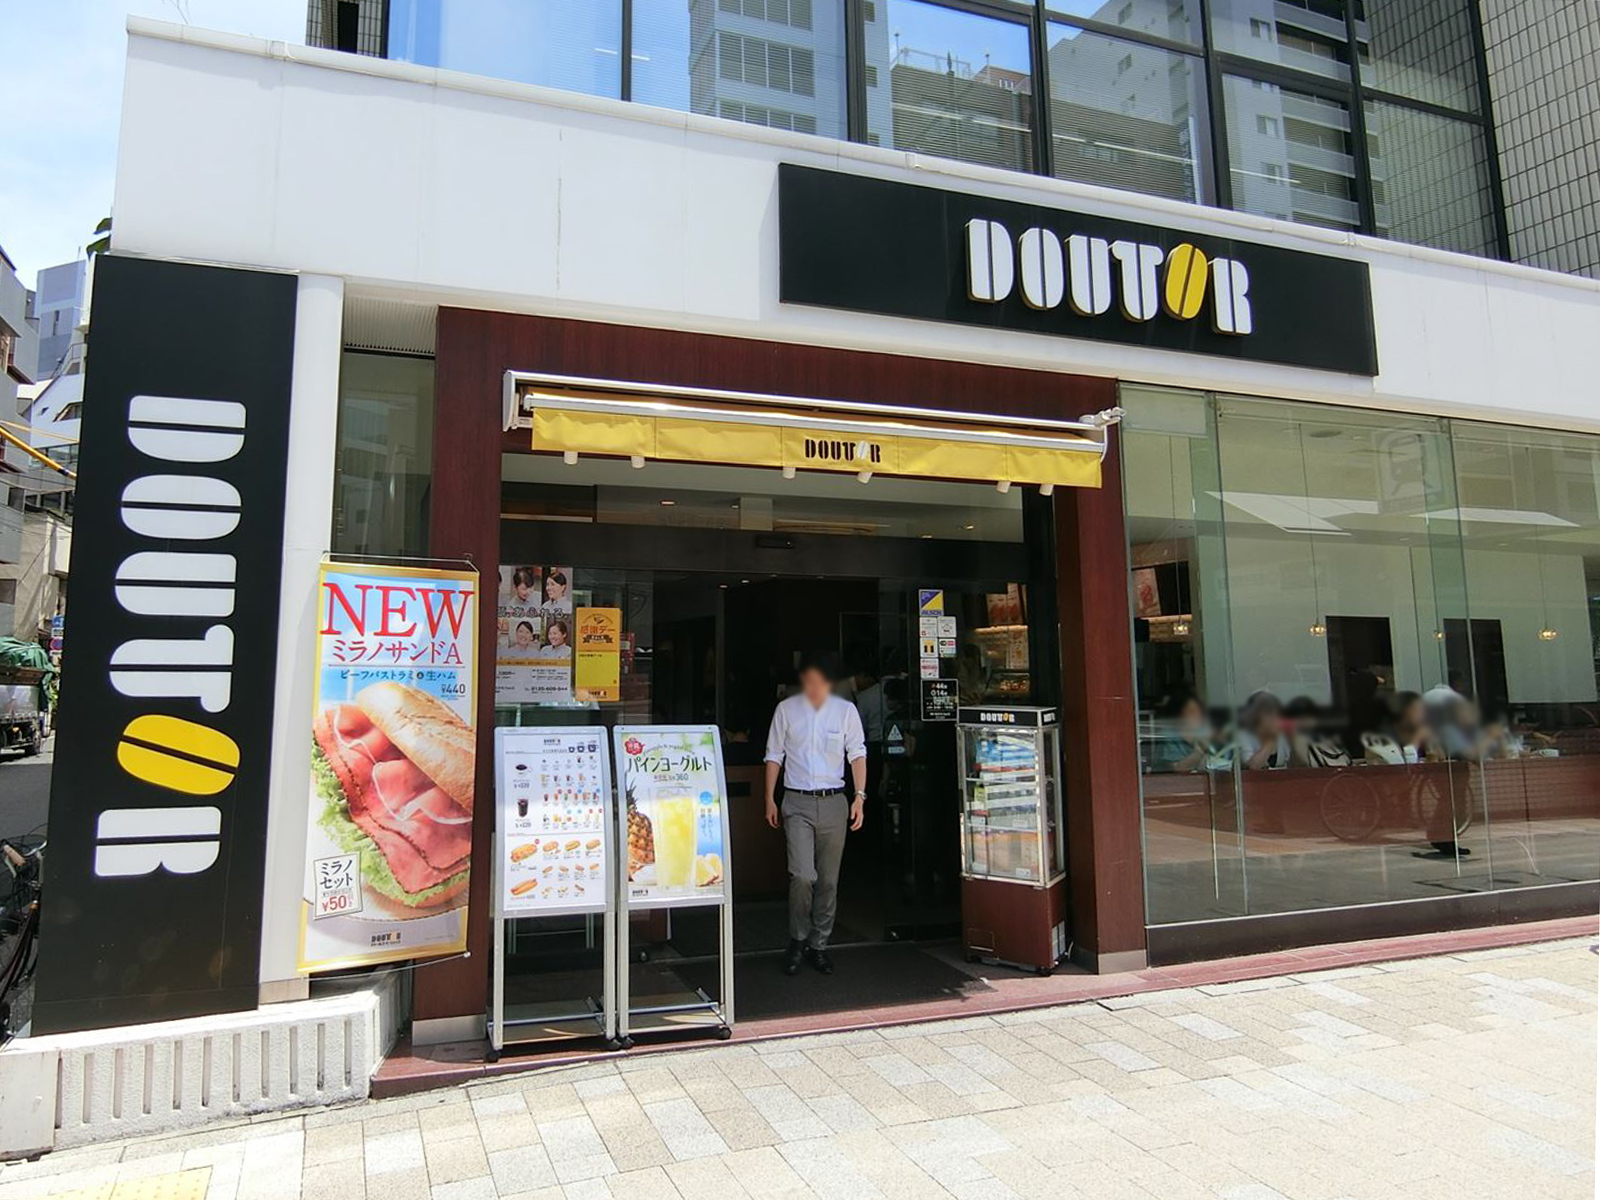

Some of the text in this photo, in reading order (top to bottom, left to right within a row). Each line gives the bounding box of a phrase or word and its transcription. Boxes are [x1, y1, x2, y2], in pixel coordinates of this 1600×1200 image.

[965, 217, 1253, 336] DOUTOR
[804, 438, 881, 463] DOUTOR
[319, 582, 476, 640] NEW
[94, 394, 247, 877] DOUTOR
[332, 639, 464, 665] ミラノサンドA
[980, 712, 1015, 723] DOUTOR
[627, 755, 713, 773] パインヨーグルト
[320, 859, 353, 876] ミラノ
[319, 872, 353, 890] セット
[321, 895, 348, 912] ¥50
